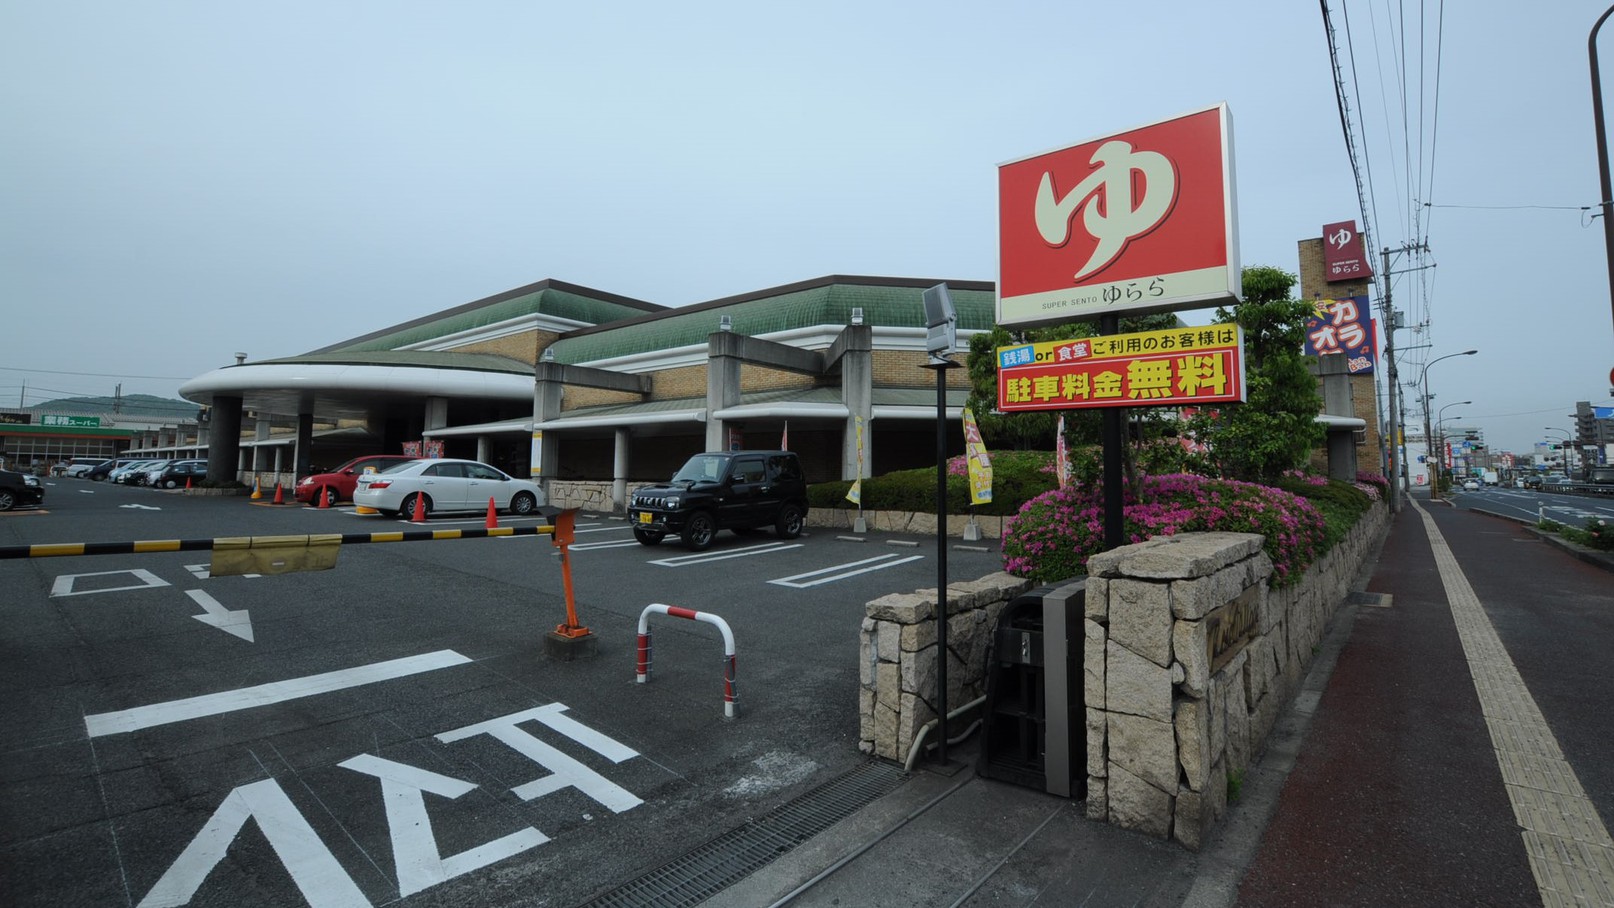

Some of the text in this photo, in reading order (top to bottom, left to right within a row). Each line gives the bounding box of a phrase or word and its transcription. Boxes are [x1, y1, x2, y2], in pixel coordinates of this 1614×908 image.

[1034, 140, 1179, 281] ゆ
[1329, 228, 1351, 250] ゆ
[1332, 264, 1360, 275] ゆらら
[1042, 276, 1165, 310] SUPER SENTO ゆらら
[1002, 328, 1235, 367] 銭湯 or 食堂 ご利用のお客様は
[1006, 352, 1227, 403] 駐車料金無料
[44, 415, 97, 426] 業務スーパー
